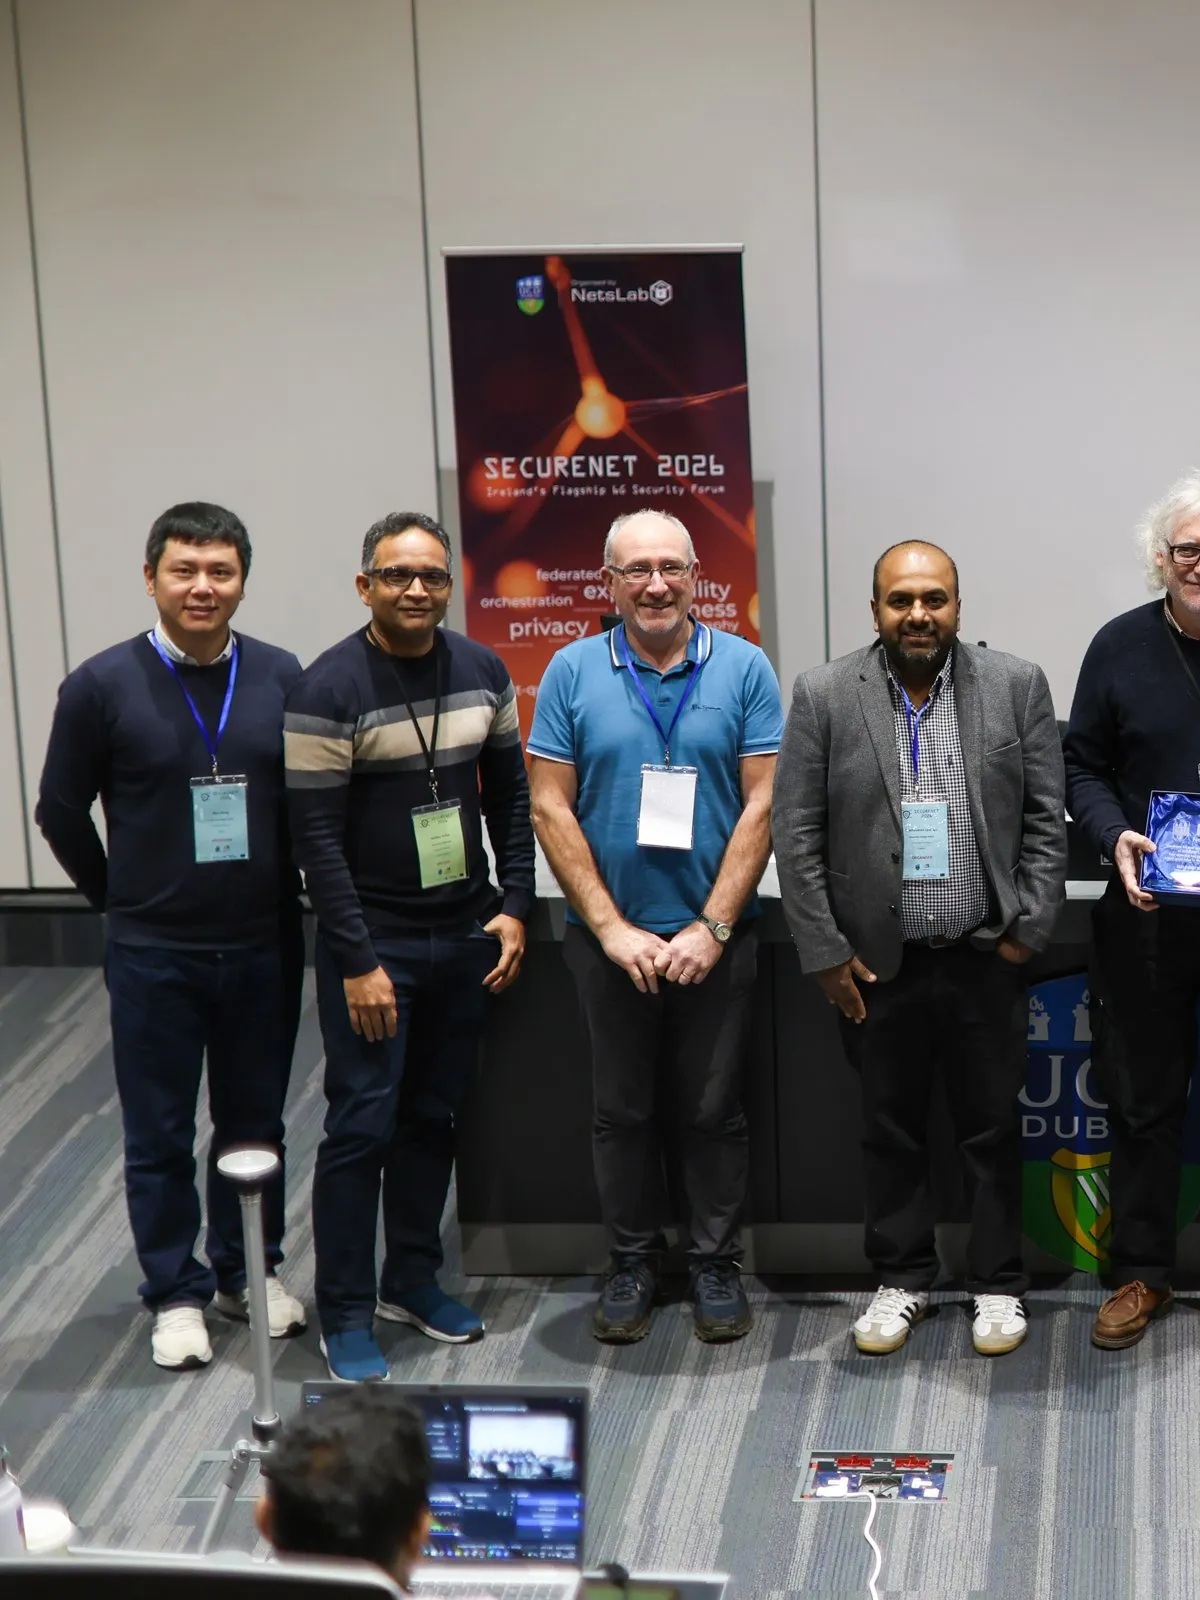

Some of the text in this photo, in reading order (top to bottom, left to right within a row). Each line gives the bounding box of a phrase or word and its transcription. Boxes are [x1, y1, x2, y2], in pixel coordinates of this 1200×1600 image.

[571, 287, 649, 303] NetsLab
[484, 454, 725, 480] SECURENET 2026
[486, 485, 547, 498] Ireland's
[552, 485, 606, 497] Flagship
[632, 484, 685, 497] Security
[691, 484, 726, 495] Forum
[480, 593, 574, 609] orchestration
[688, 603, 738, 619] ness
[509, 617, 590, 642] privacy
[1021, 1114, 1110, 1139] DUB
